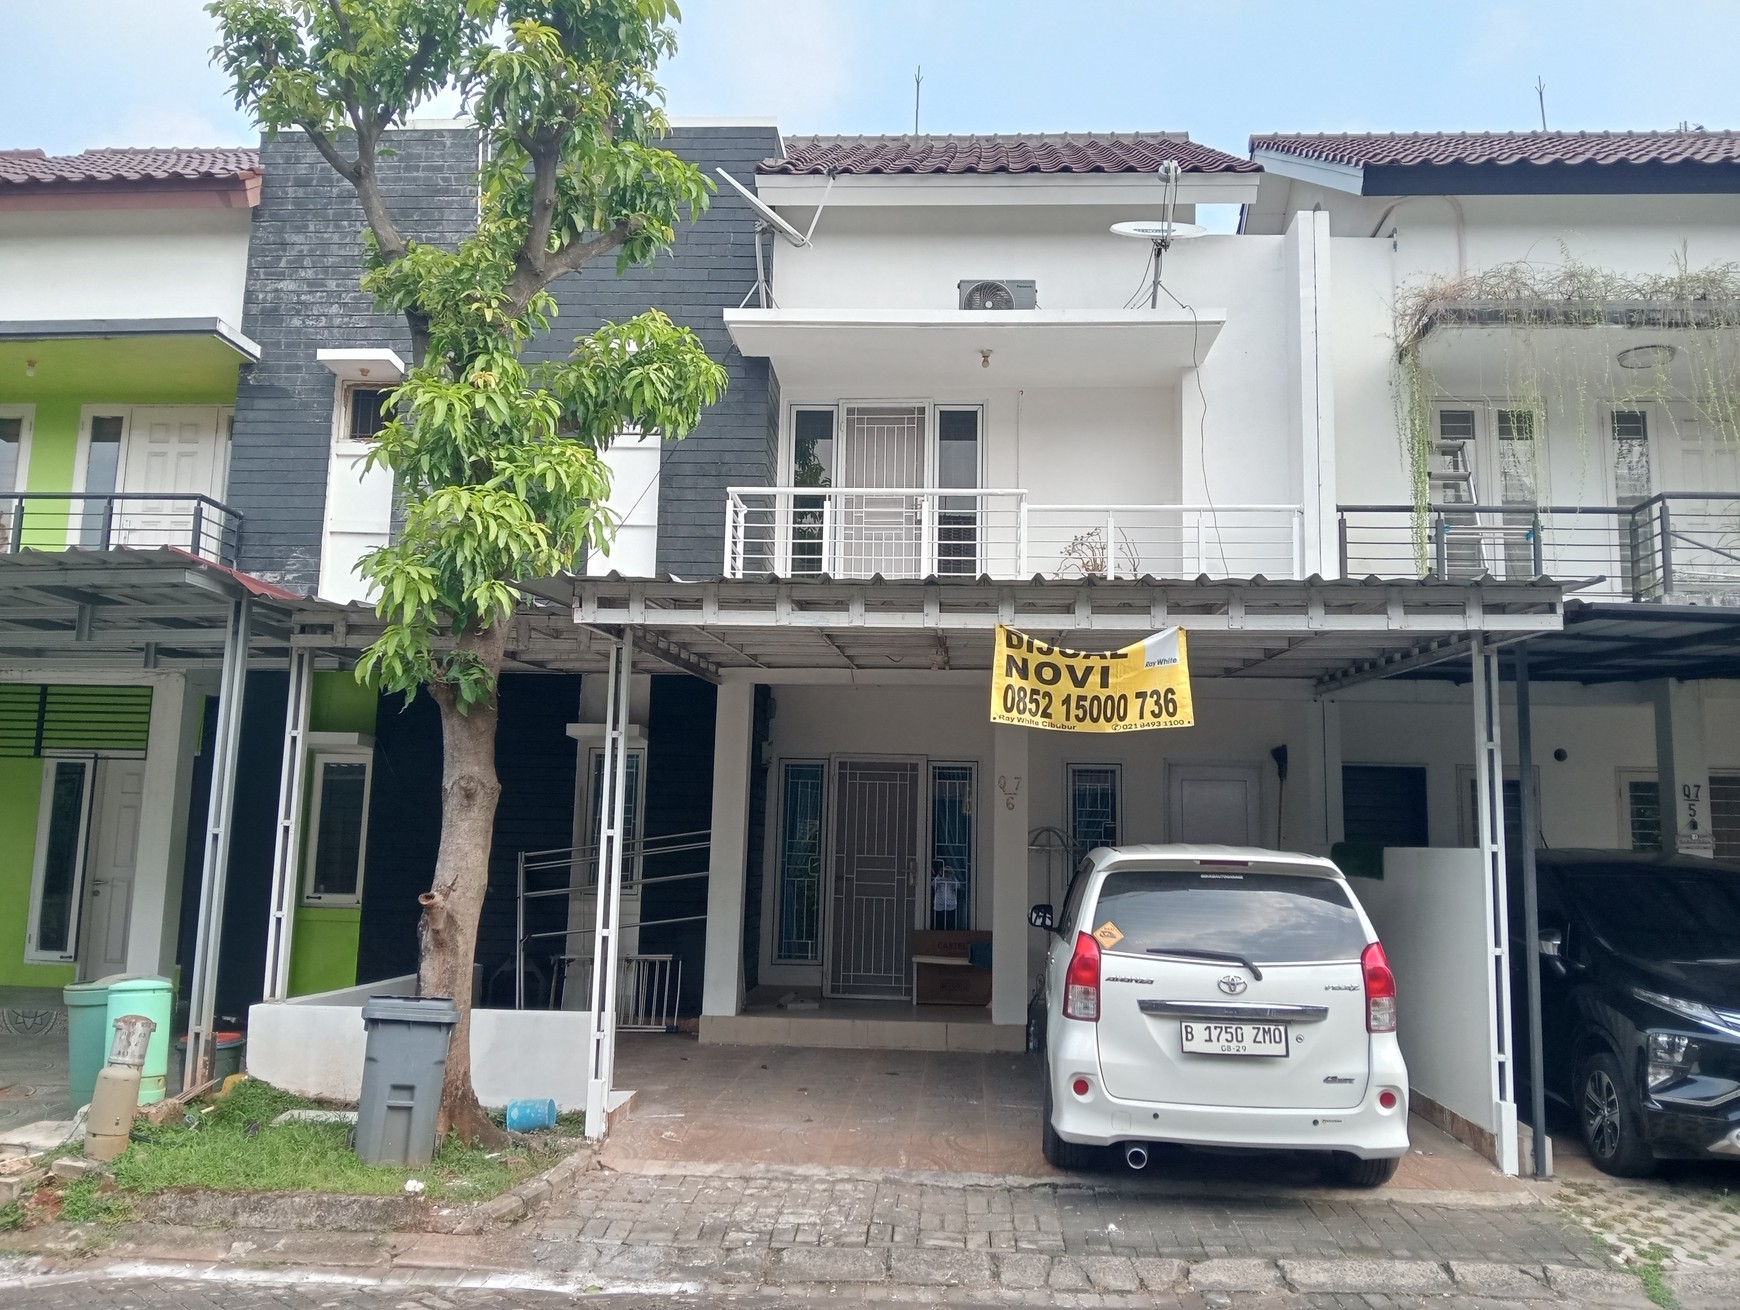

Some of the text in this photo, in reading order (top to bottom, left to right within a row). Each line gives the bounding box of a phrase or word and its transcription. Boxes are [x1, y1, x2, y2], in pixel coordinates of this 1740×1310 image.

[1005, 654, 1110, 689] NOVI
[1003, 683, 1178, 723] 0852 15000 736
[999, 714, 1077, 730] Ray White Cibubur
[1163, 719, 1185, 727] 1100
[1006, 796, 1014, 810] 6
[1688, 803, 1697, 817] 5
[1184, 1025, 1283, 1044] B 1750 ZMO
